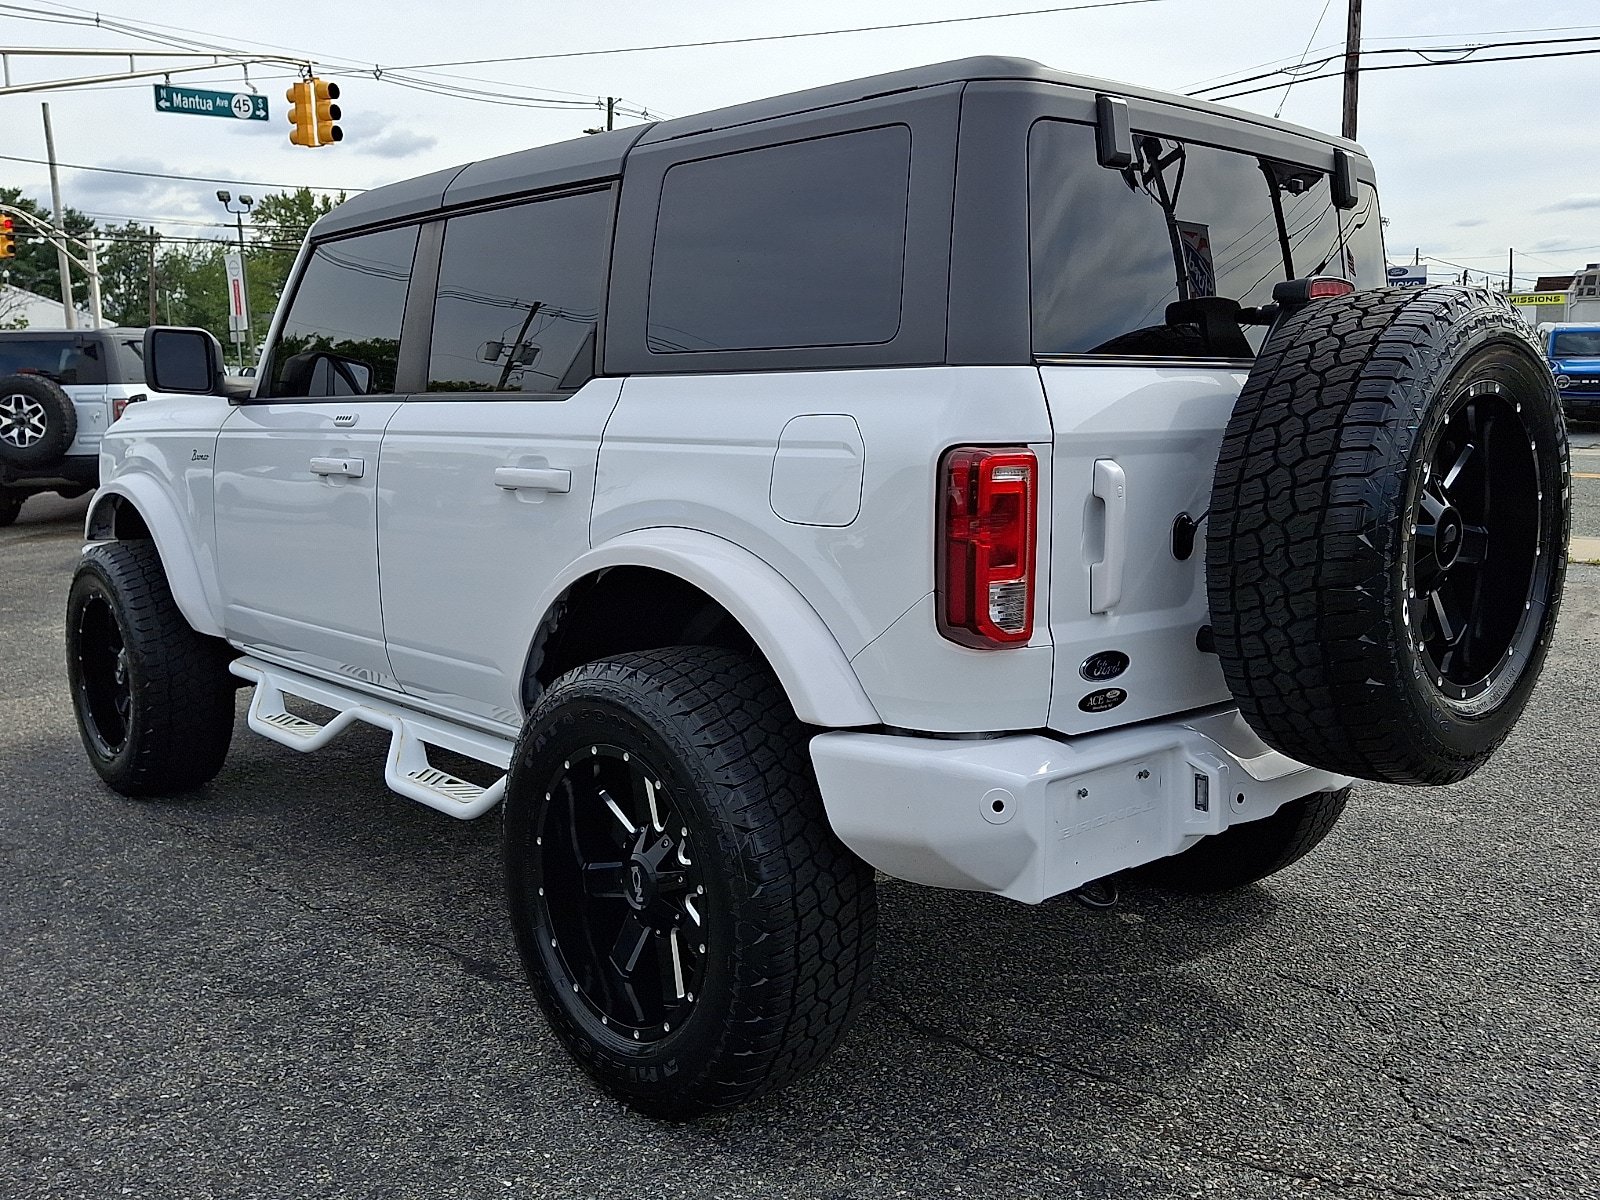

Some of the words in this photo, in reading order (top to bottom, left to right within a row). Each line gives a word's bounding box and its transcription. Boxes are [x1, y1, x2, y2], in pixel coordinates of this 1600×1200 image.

[172, 93, 213, 111] Mantua
[216, 96, 229, 108] Ave
[233, 98, 251, 113] 45
[257, 98, 264, 109] S
[1509, 295, 1561, 304] MISSIONS
[1093, 659, 1121, 677] Ford
[1087, 694, 1105, 706] ACE
